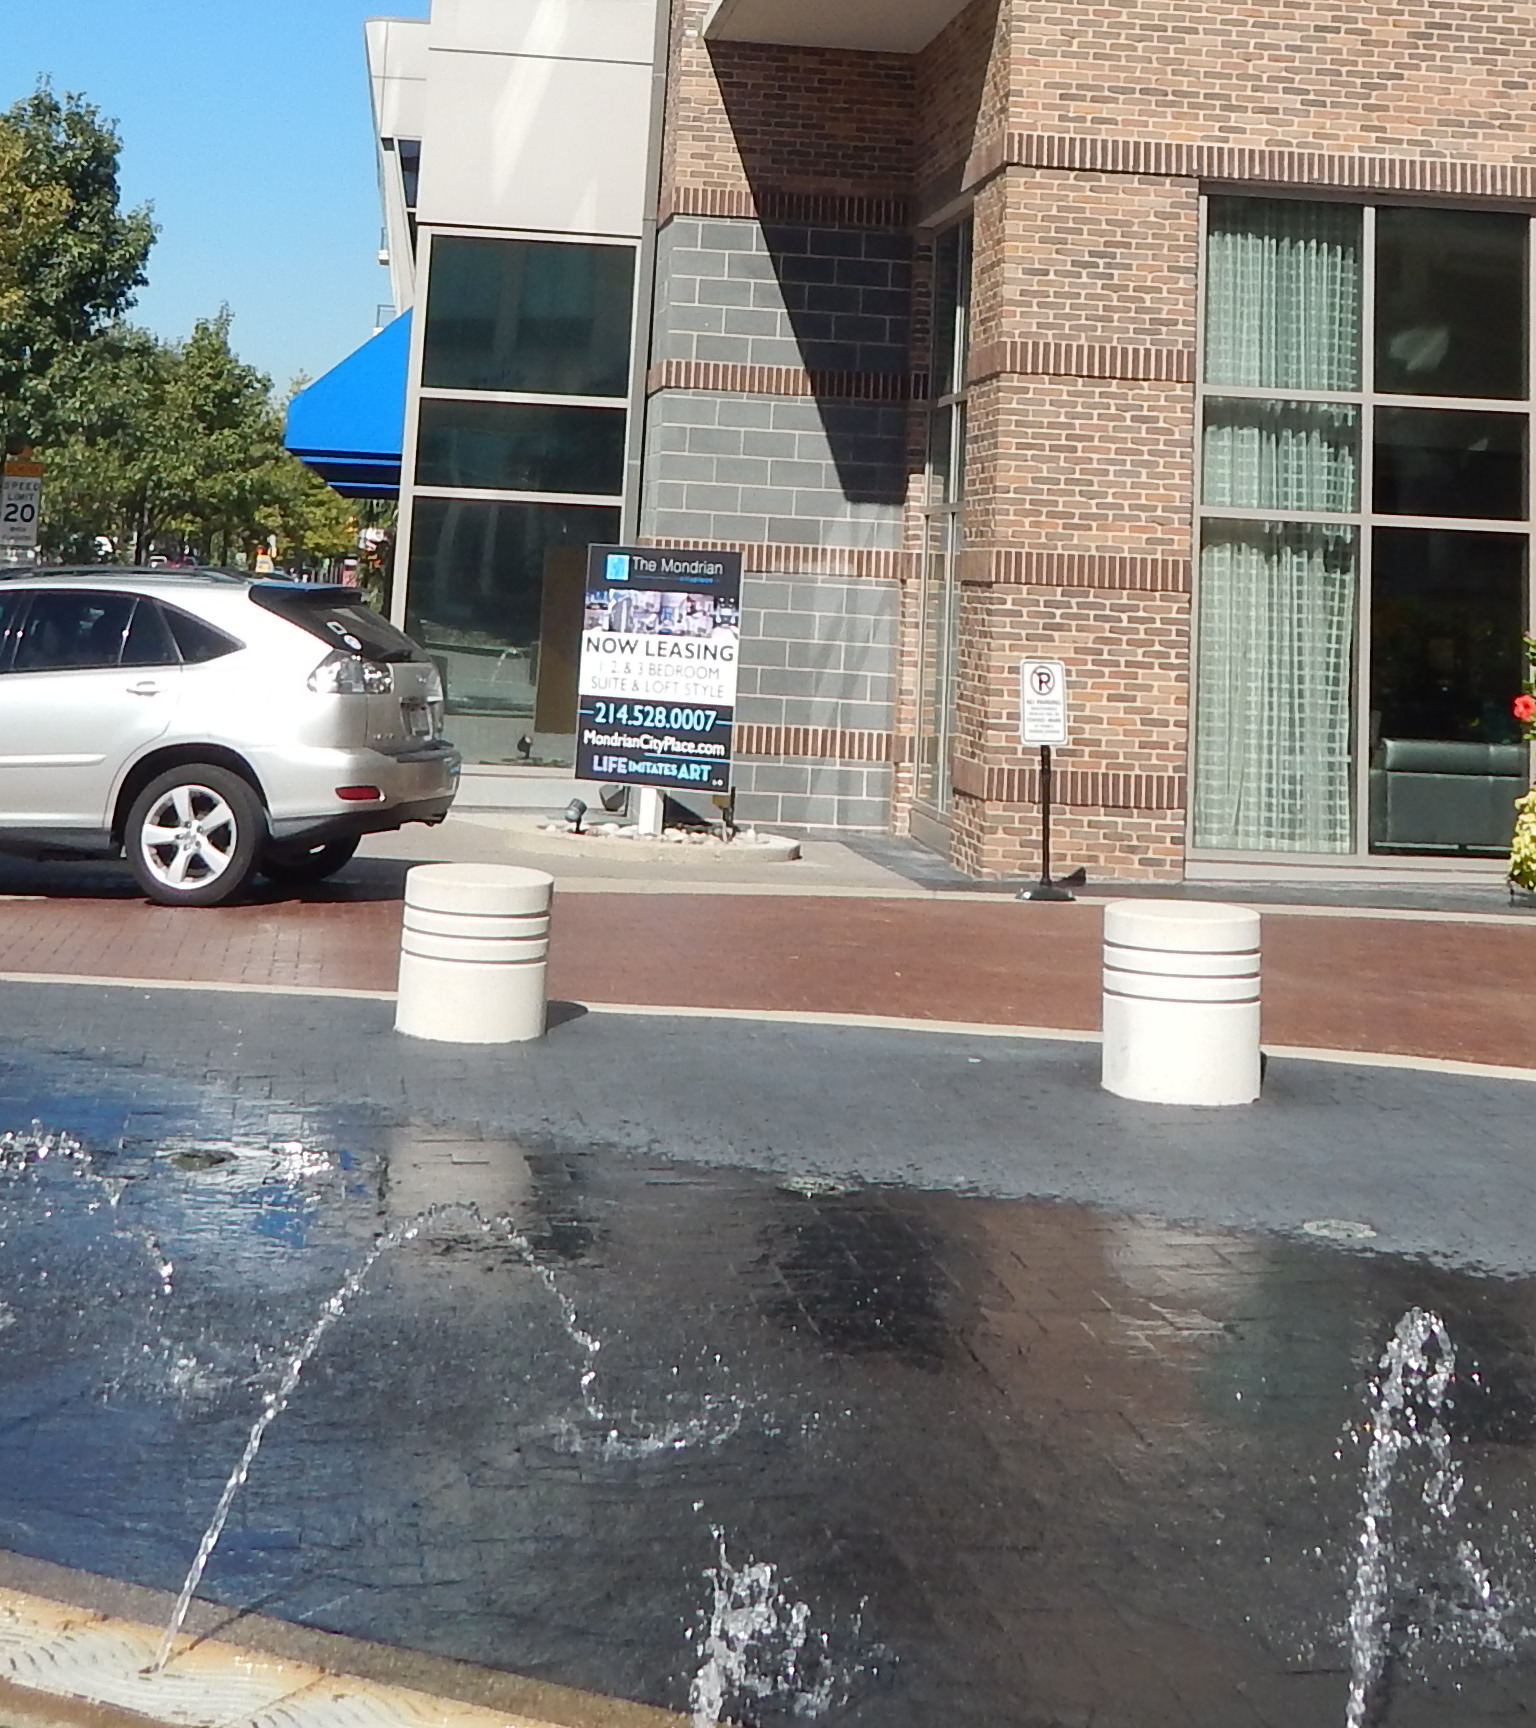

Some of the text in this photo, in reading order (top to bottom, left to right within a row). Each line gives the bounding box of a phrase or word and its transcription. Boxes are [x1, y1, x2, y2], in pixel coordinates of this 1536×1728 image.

[4, 481, 40, 491] SPEED
[7, 493, 35, 501] LIMIT
[4, 503, 35, 523] 20
[632, 556, 723, 575] The Mondrian
[586, 636, 735, 662] NOW LEASING
[638, 663, 643, 675] 3
[648, 663, 720, 680] BEDROOM
[591, 676, 724, 698] SUITE & LOFT STYLE
[593, 702, 717, 732] 214.528.0007
[582, 730, 725, 756] MondrianCityPlace.com
[593, 755, 712, 781] LIFE IMITATES ART
